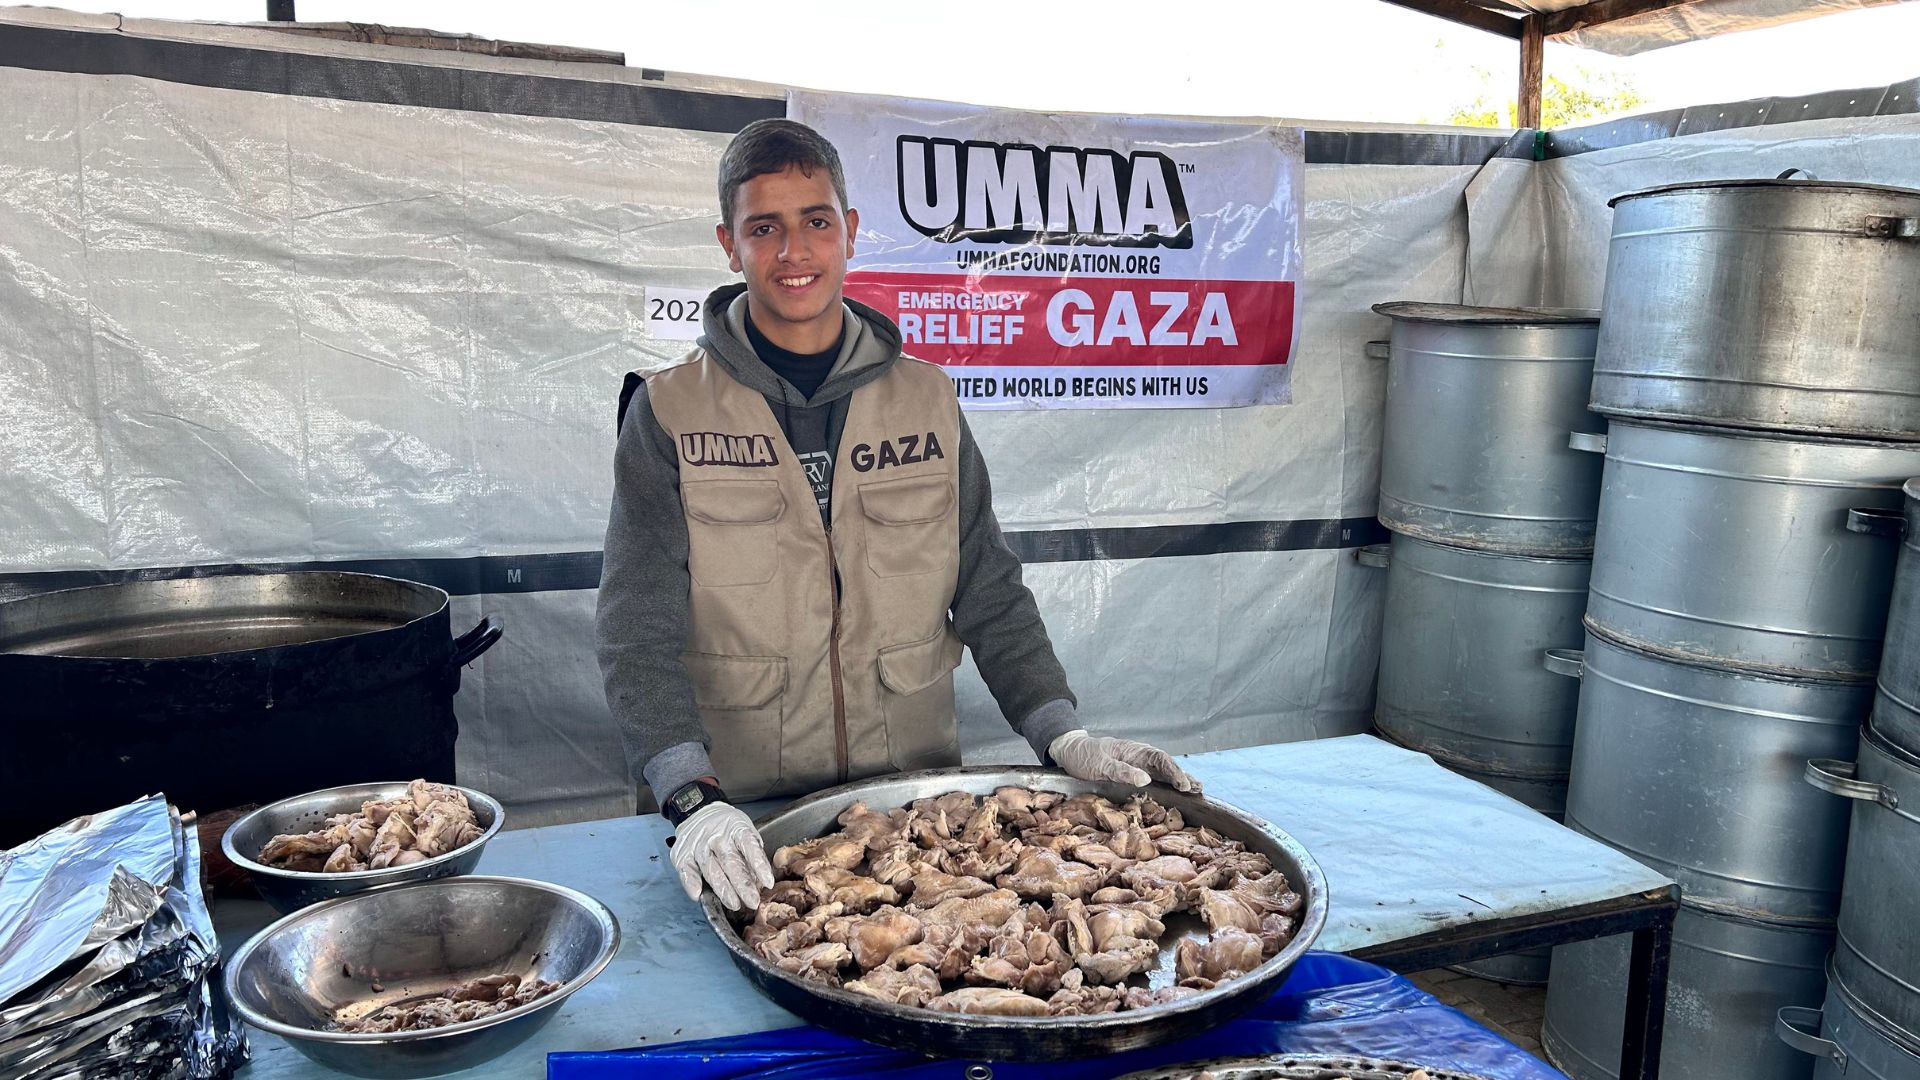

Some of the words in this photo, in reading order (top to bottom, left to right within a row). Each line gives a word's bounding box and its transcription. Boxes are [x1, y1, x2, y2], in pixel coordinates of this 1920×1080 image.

[897, 135, 1193, 249] UMMA
[1179, 163, 1196, 173] TM
[956, 250, 1161, 275] UMMAFOUNDATION.ORG
[898, 291, 1024, 311] EMERGENCY
[898, 313, 1025, 345] RELIEF
[1046, 288, 1239, 347] GAZA
[952, 377, 998, 398] ITED
[1002, 377, 1067, 398] WORLD
[1072, 377, 1136, 397] BEGINS
[1141, 377, 1182, 396] WITH
[1186, 376, 1209, 396] US
[680, 432, 779, 468] UMMA
[850, 431, 945, 473] GAZA
[507, 568, 522, 584] M
